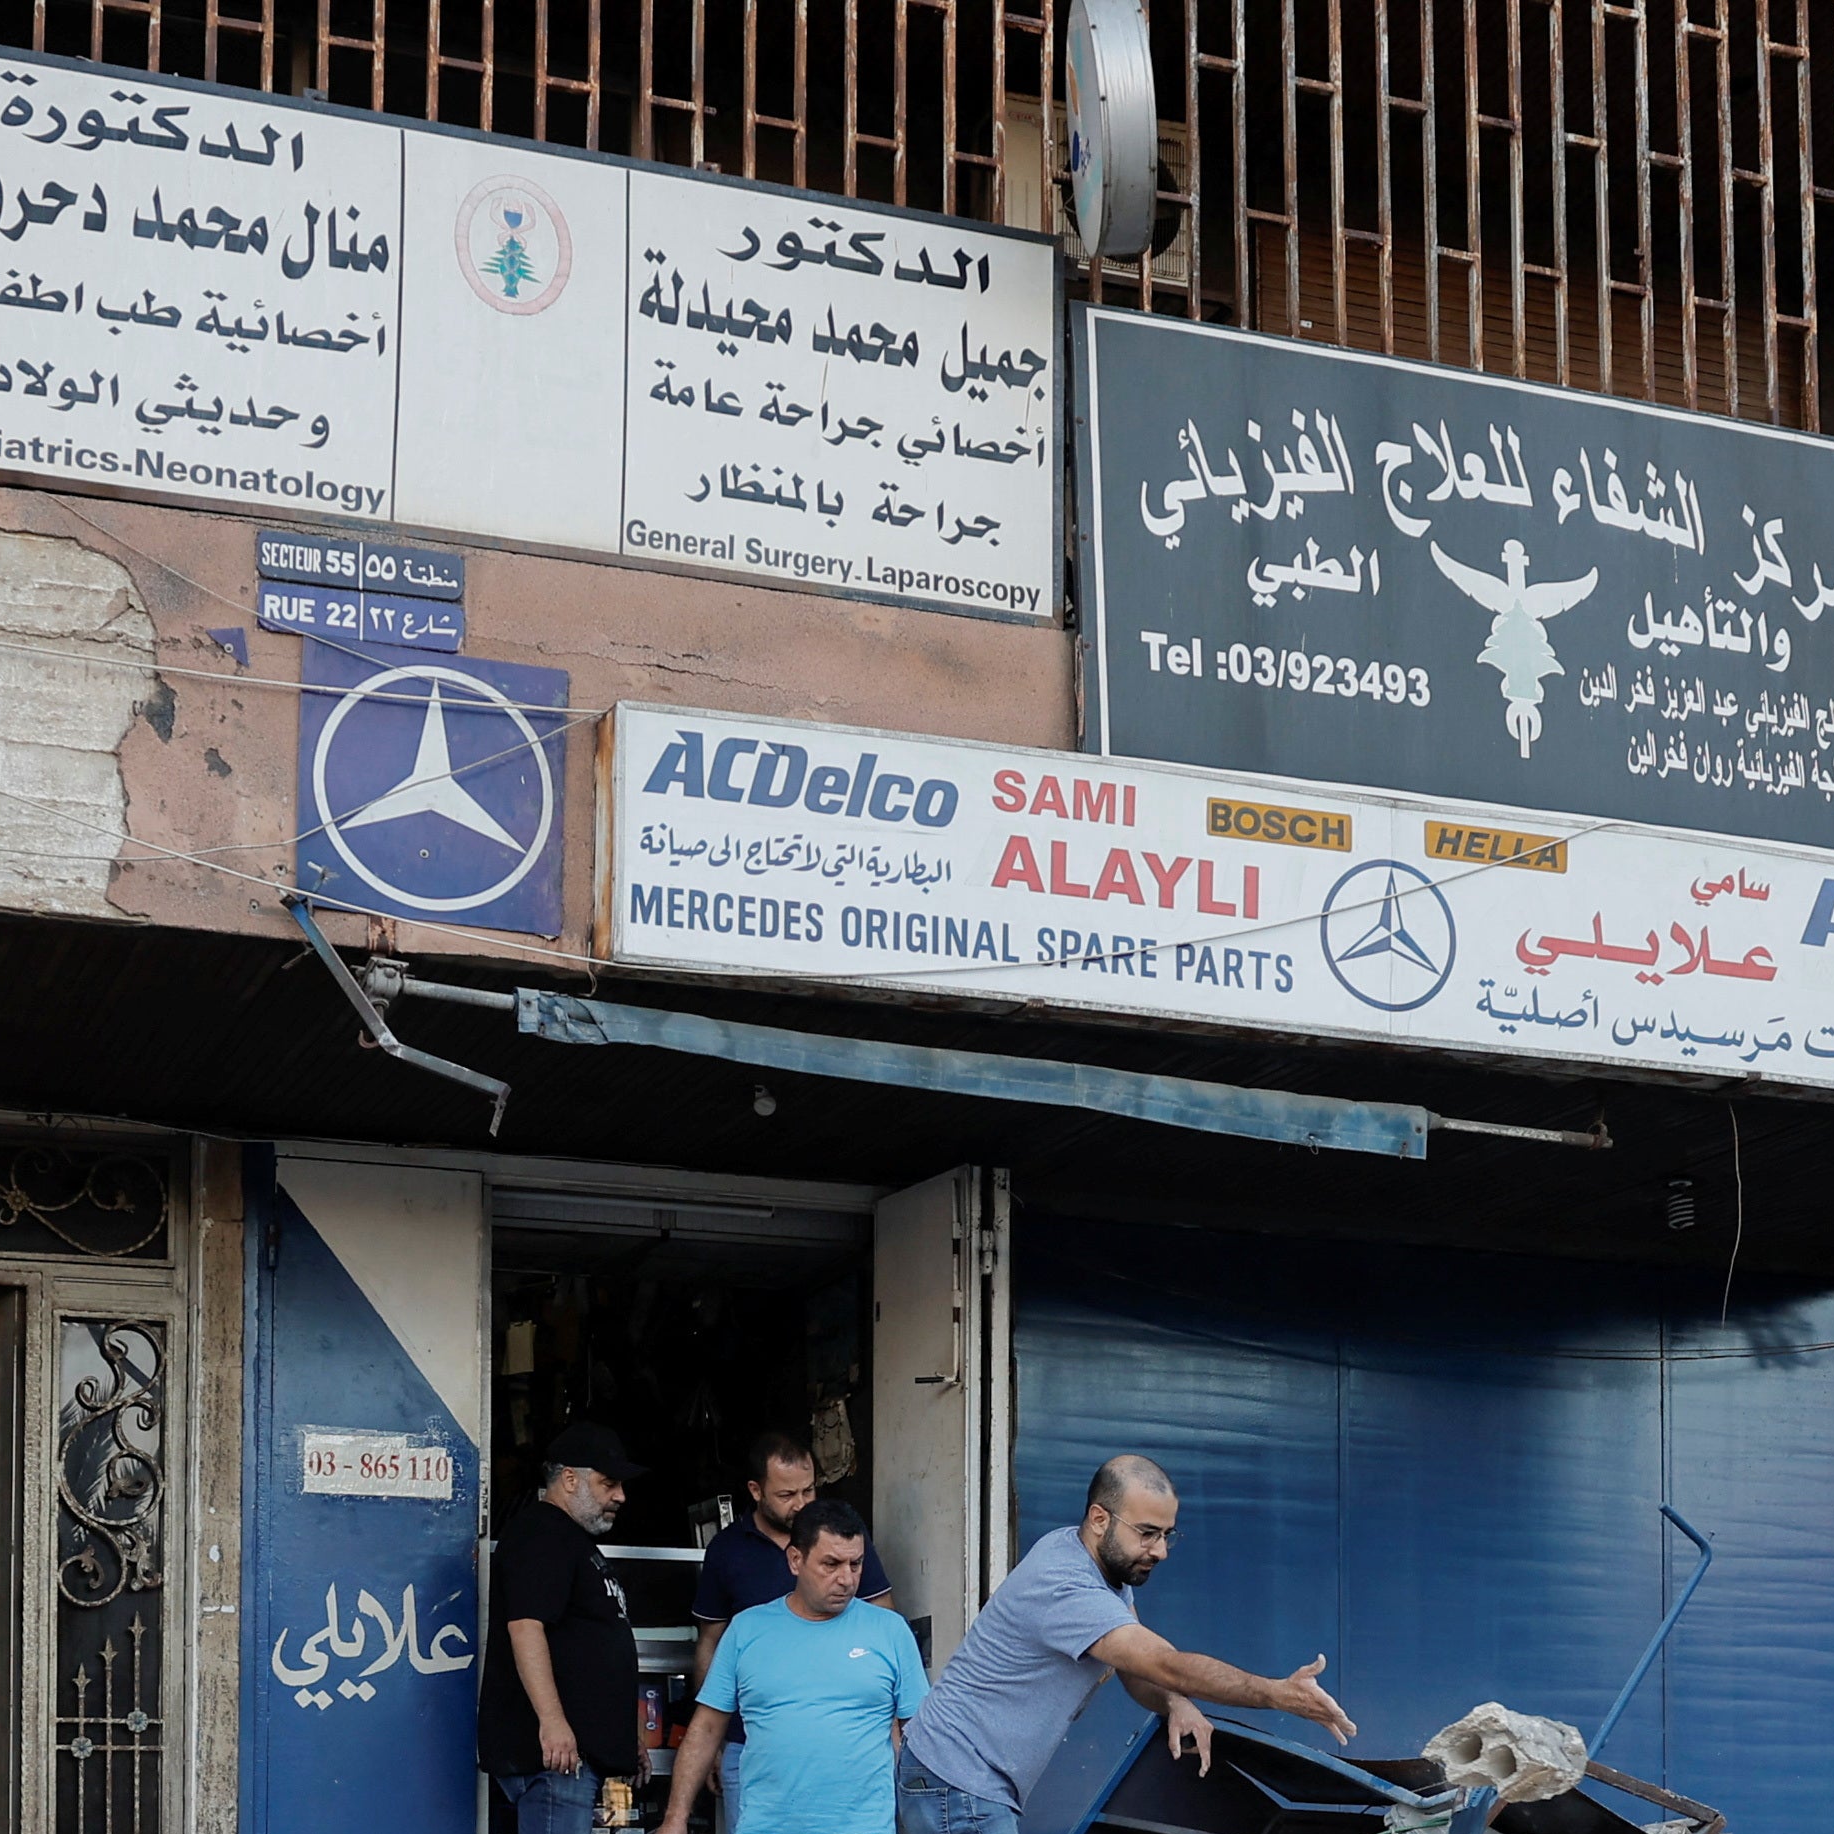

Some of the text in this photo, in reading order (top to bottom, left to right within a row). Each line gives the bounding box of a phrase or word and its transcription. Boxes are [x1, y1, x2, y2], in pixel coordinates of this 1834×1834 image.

[0, 71, 303, 172] الدكتورة
[133, 185, 270, 255] محمد
[281, 200, 390, 280] منال
[715, 216, 990, 294] الدكتور
[96, 289, 182, 336] طب
[196, 290, 386, 357] أخصائية
[638, 247, 1048, 402] جميل محمد محيدلة
[134, 373, 330, 449] وحديثي
[649, 358, 1045, 469] أخصائي جراحة عامة
[684, 462, 1002, 547] جراحة بالمنظار
[1140, 407, 1357, 550] الفيزيائي
[1375, 418, 1535, 539] للعلاج
[1551, 447, 1705, 557] الشفاء
[261, 541, 356, 577] SECTEUR 55
[625, 519, 735, 561] General
[365, 556, 459, 589] منطقة ٥٥
[263, 594, 357, 629] RUE 22
[369, 606, 458, 640] شارع ٢٢
[1246, 535, 1793, 672] والتأهيل الطبي
[1579, 662, 1618, 707] الدين
[1624, 664, 1656, 714] فخر
[1660, 676, 1706, 722] العزيز
[1713, 688, 1739, 728] عبد
[1744, 689, 1811, 739] الفيزيائي
[642, 729, 960, 829] ACDelco
[1692, 740, 1734, 789] روان
[1736, 737, 1807, 796] الفيزيائية
[991, 769, 1137, 829] SAMI
[639, 822, 708, 867] صيانة
[1211, 802, 1348, 851] BOSCH
[1434, 823, 1563, 871] HELLA
[821, 843, 865, 887] التي
[866, 846, 953, 895] البطارية
[990, 834, 1262, 921] ALAYLI
[1690, 866, 1771, 907] سامي
[629, 883, 1295, 995] MERCEDES ORIGINAL SPARE PARTS
[1514, 912, 1779, 987] علايلي
[307, 1450, 337, 1477] 03
[360, 1452, 401, 1480] 865
[407, 1456, 450, 1483] 110
